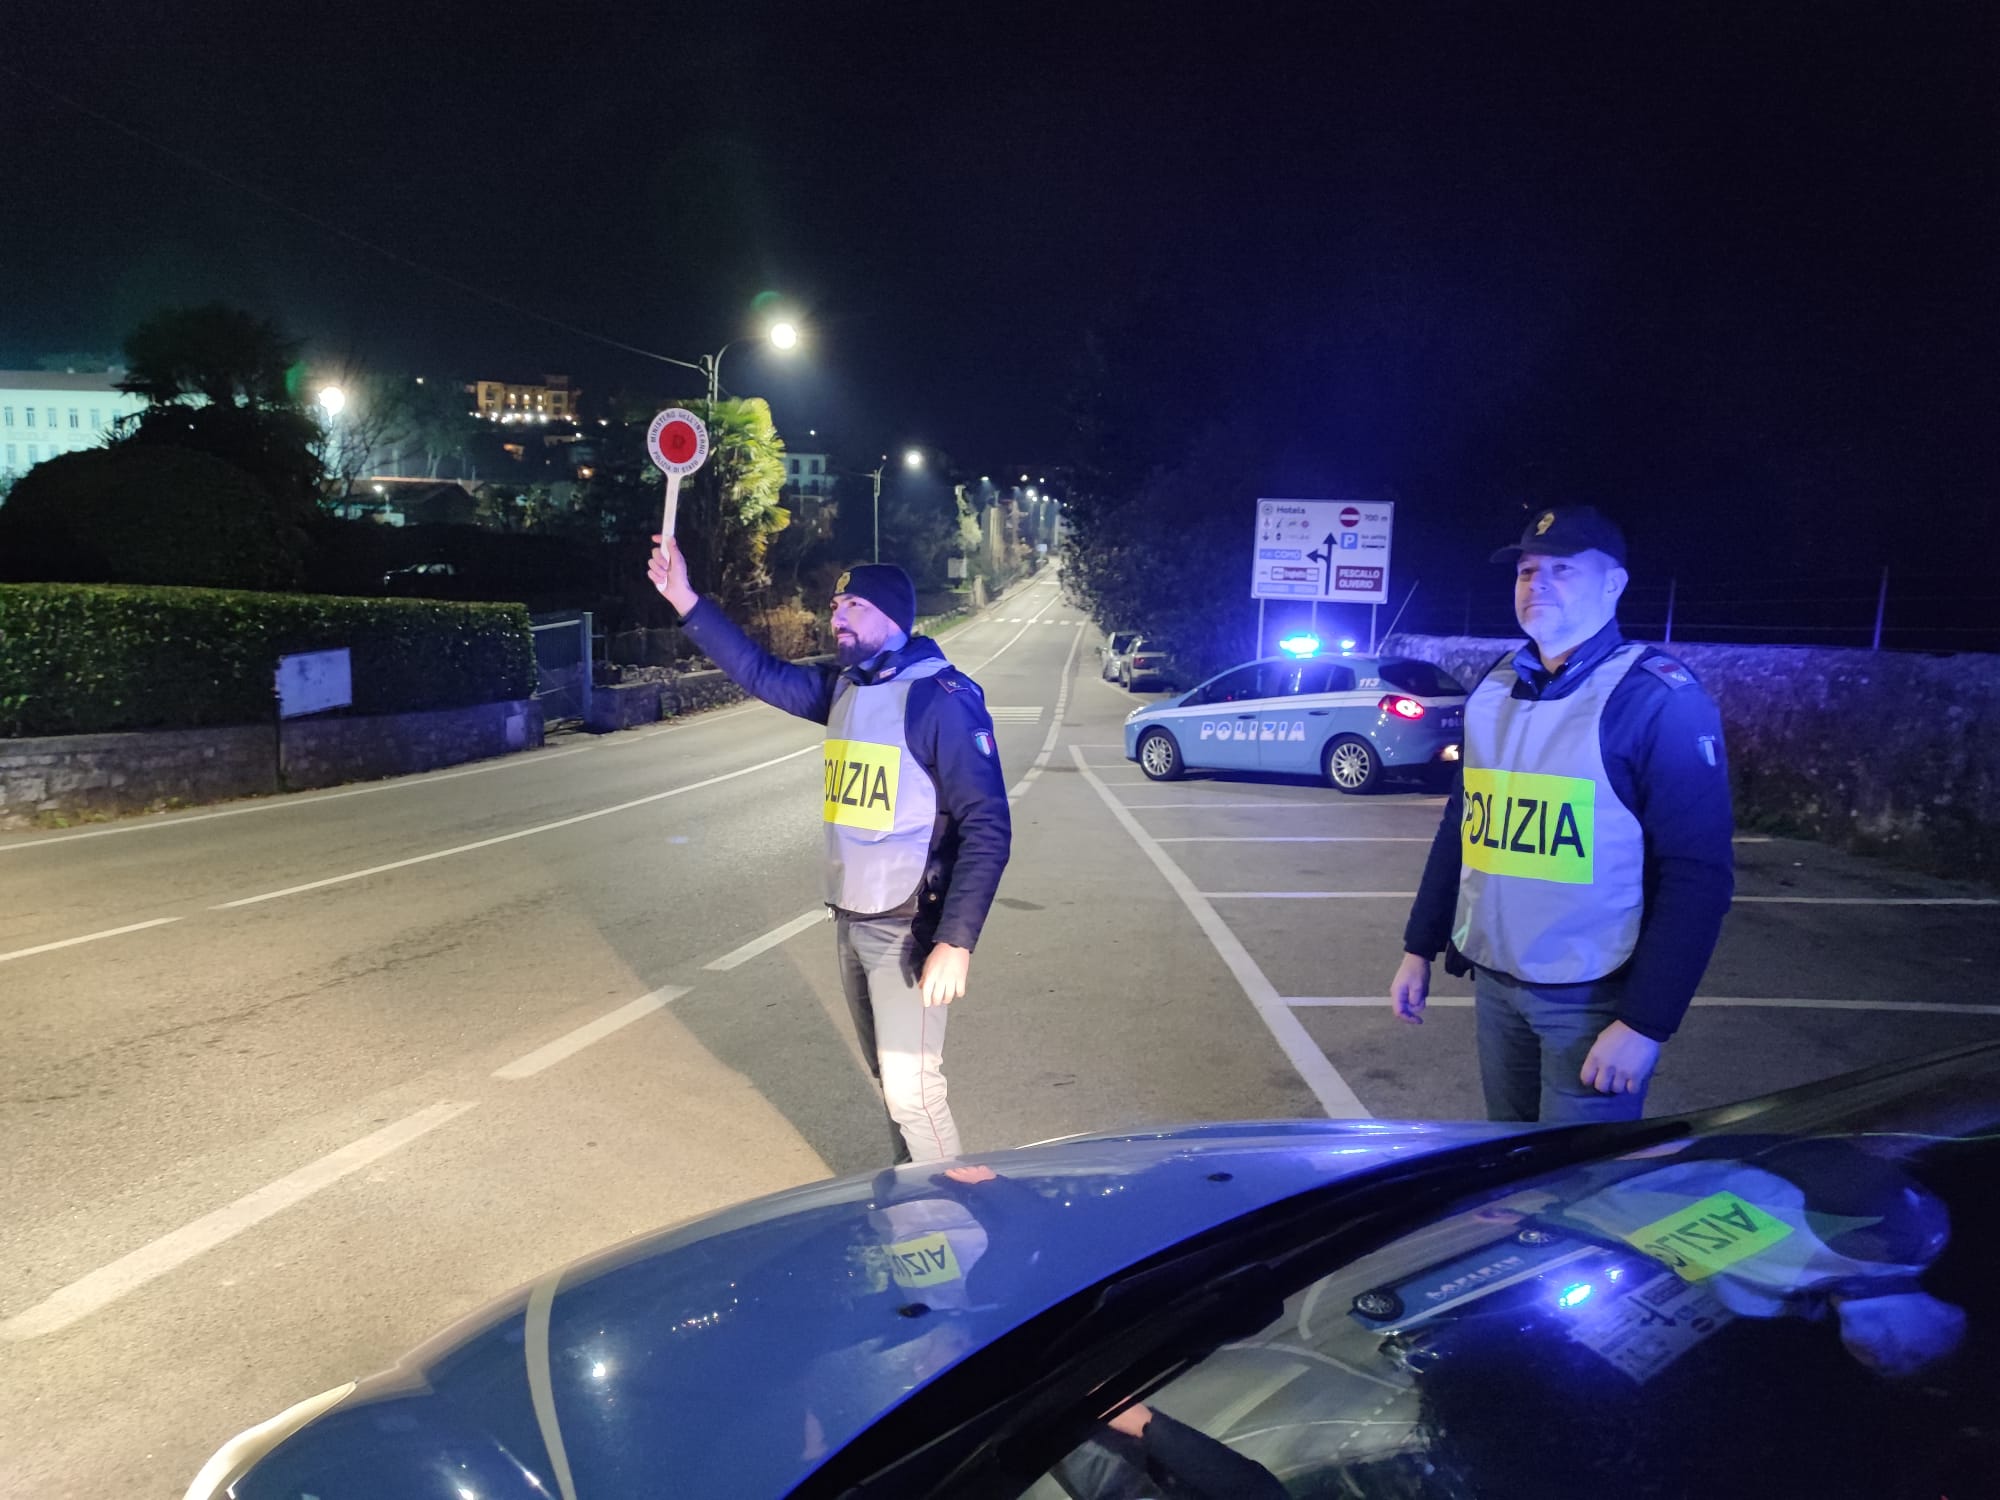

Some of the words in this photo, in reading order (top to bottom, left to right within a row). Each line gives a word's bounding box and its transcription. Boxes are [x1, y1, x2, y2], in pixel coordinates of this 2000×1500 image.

[1276, 505, 1306, 514] Hotels
[1343, 533, 1356, 548] P
[1359, 678, 1380, 688] 113
[1200, 721, 1305, 742] POLIZIA
